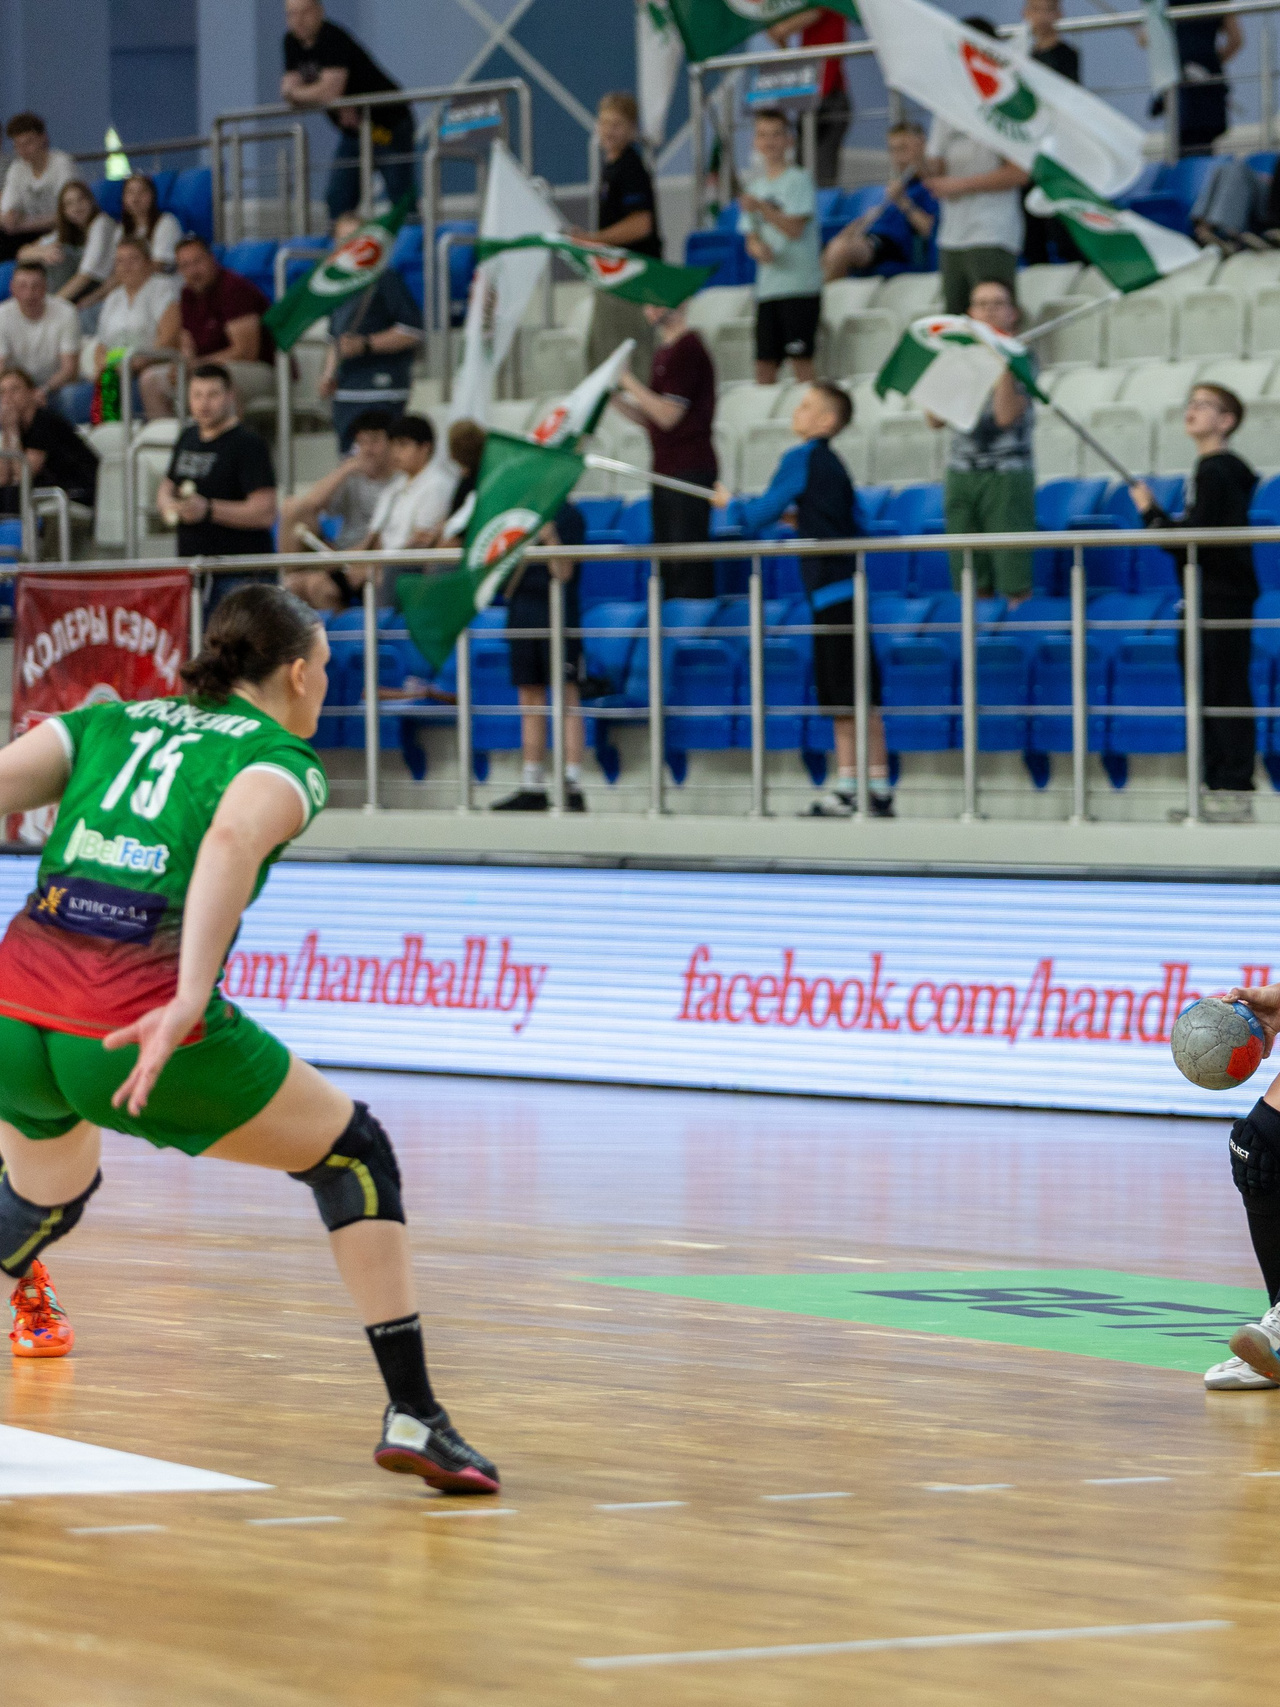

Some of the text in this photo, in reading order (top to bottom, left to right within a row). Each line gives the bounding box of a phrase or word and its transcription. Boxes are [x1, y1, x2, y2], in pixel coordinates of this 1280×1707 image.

[23, 604, 109, 688] КОЛЕРЫ
[100, 726, 203, 820] 15
[79, 829, 169, 874] BelFert
[222, 929, 548, 1034] om/handball.by
